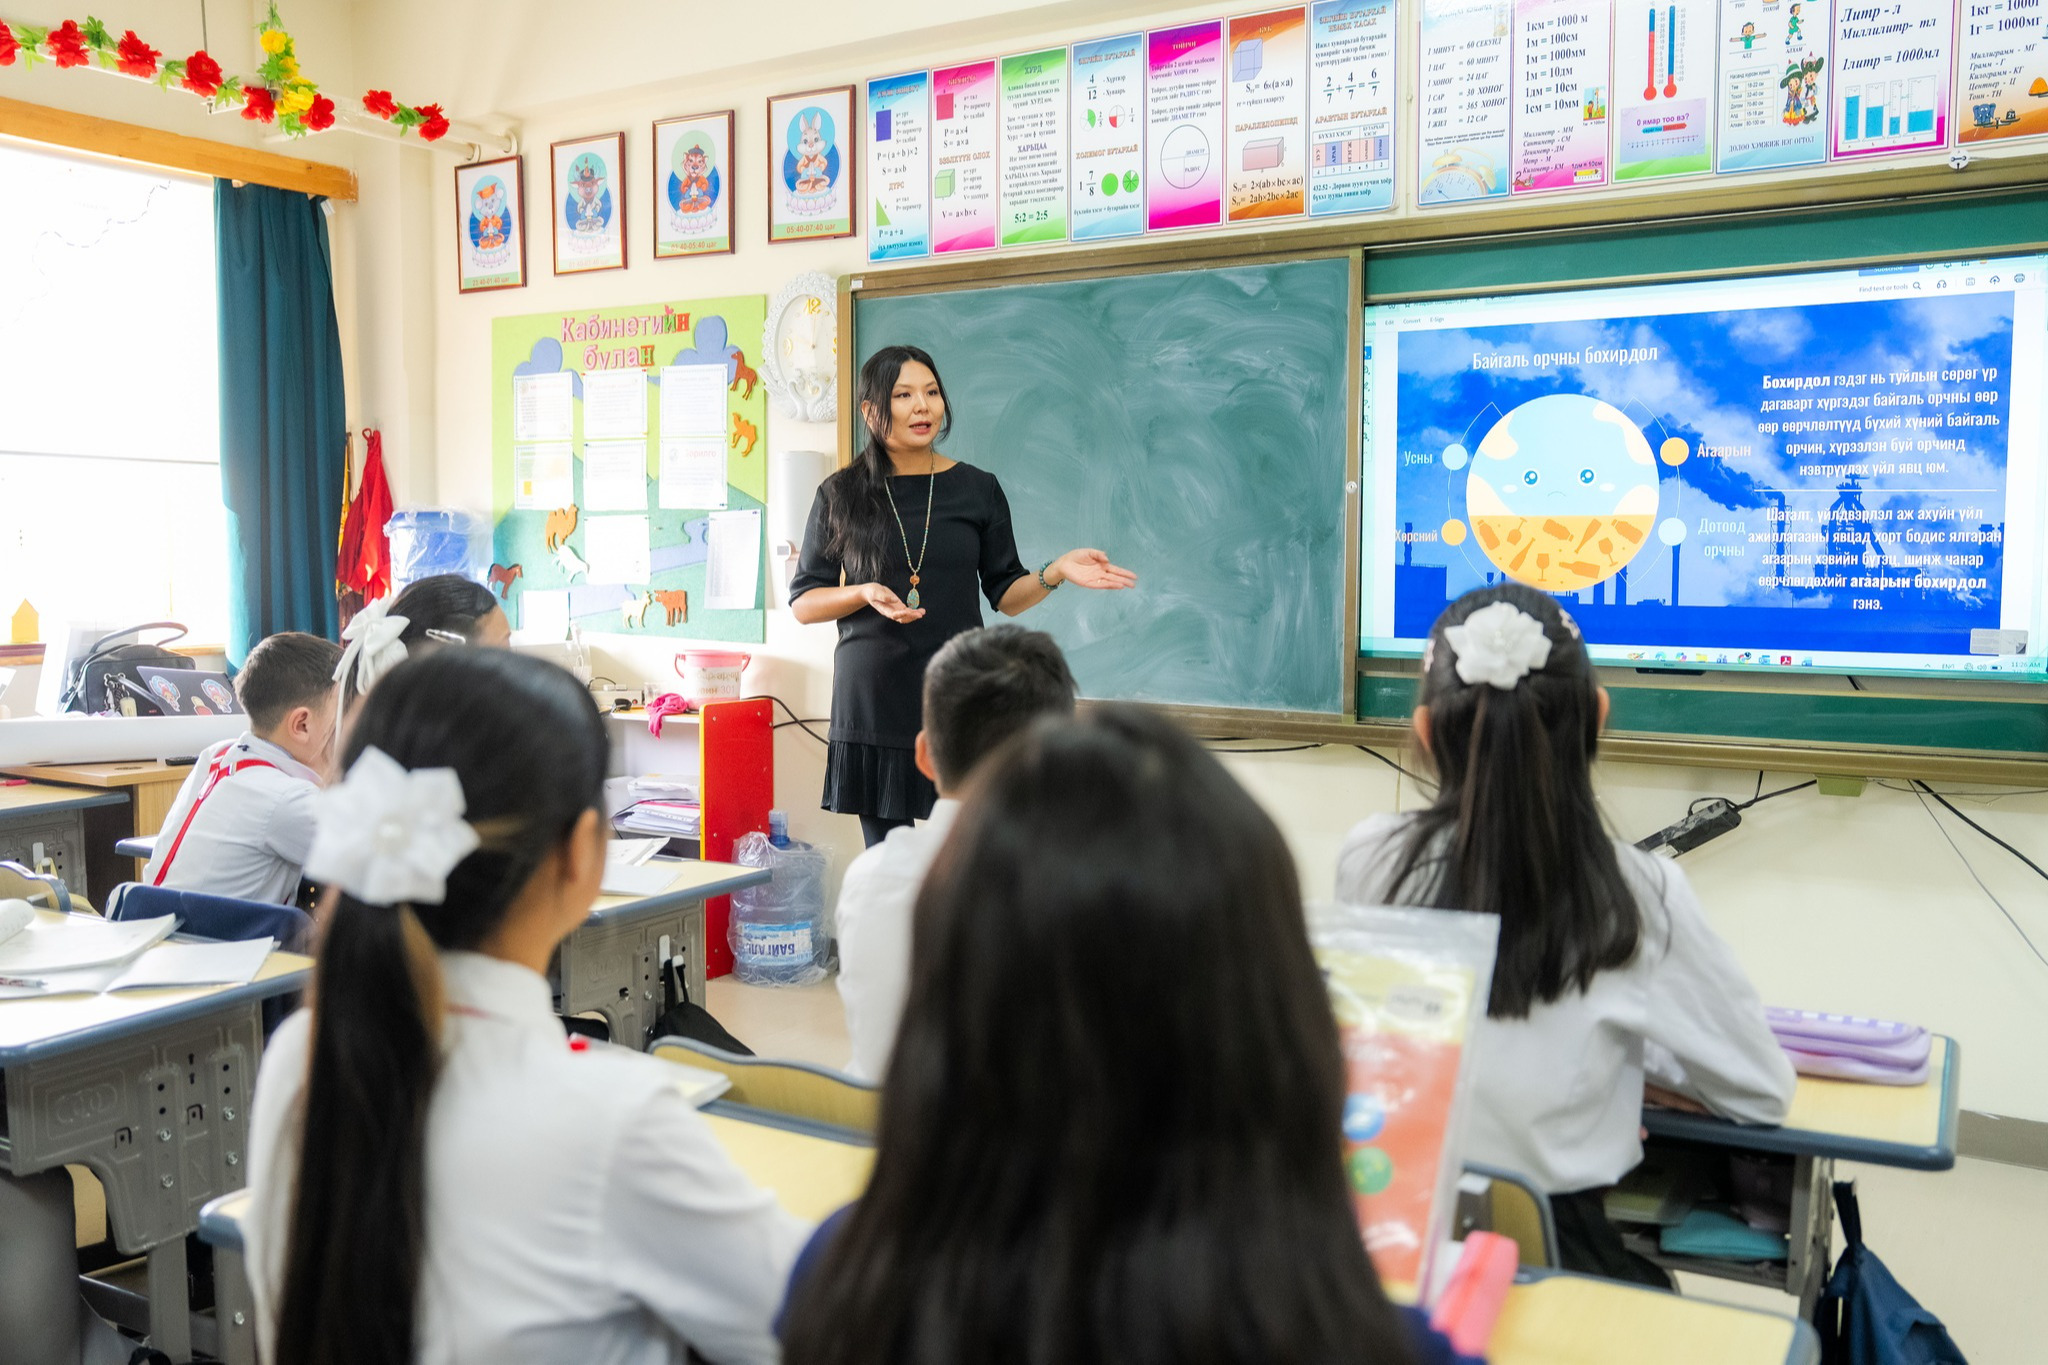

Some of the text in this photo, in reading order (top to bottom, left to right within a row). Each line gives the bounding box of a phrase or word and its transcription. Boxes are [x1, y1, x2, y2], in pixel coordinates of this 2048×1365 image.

[1841, 7, 1880, 22] Литр
[1970, 5, 1991, 16] 1кг
[1527, 14, 1587, 31] 1км 1000 м
[1970, 16, 2042, 36] 1г 1000мг
[1433, 45, 1455, 55] МИНУТ
[1467, 41, 1474, 49] 60
[1527, 32, 1578, 48] 1м 100см
[1527, 48, 1585, 65] 1м 1000мм
[1843, 48, 1940, 70] 1литр 1000мл
[1526, 66, 1572, 81] 1м 10дм
[1478, 84, 1504, 95] ХОНОГ
[1526, 82, 1577, 97] 1дм 10см
[1467, 102, 1477, 110] 365
[1481, 97, 1507, 108] ХОНОГ
[1526, 99, 1578, 114] 1см 10мм
[1467, 115, 1474, 123] 12
[1015, 213, 1026, 223] 5:2
[561, 306, 690, 342] Кабинетийн
[1473, 346, 1658, 370] Байгаль орчны бохирдол
[1763, 368, 1997, 390] Бохирдол гэдэг нь туйлын сөрөг үр
[1761, 391, 1998, 413] дагаварт хүргэдэг байгаль орчны өөр
[1758, 412, 1999, 435] өөр өөрчлөлтүүд бүхий хүний байгаль
[1696, 443, 1752, 460] Агаарын
[1786, 437, 1965, 456] орчин, хүрээлэн буй орчинд
[1404, 450, 1432, 466] Усны
[1800, 461, 1948, 477] нэвтрүүлэх үйл явц юм.
[1766, 507, 1983, 522] Шаталт, үйлдвэрлэл аж ахуйн үйл
[1698, 518, 1746, 536] Дотоод
[1395, 529, 1438, 544] Хөрсний
[1748, 529, 2002, 546] ажиллагааны явцад хорт бодис ялгаран
[1704, 545, 1744, 560] орчны
[1762, 552, 1984, 568] агаарын хэвийн бүтэц, шинж чанар
[1759, 575, 1986, 591] өөрчлөгдөхийг агаарын бохирдол
[1853, 599, 1883, 610] гэнэ.
